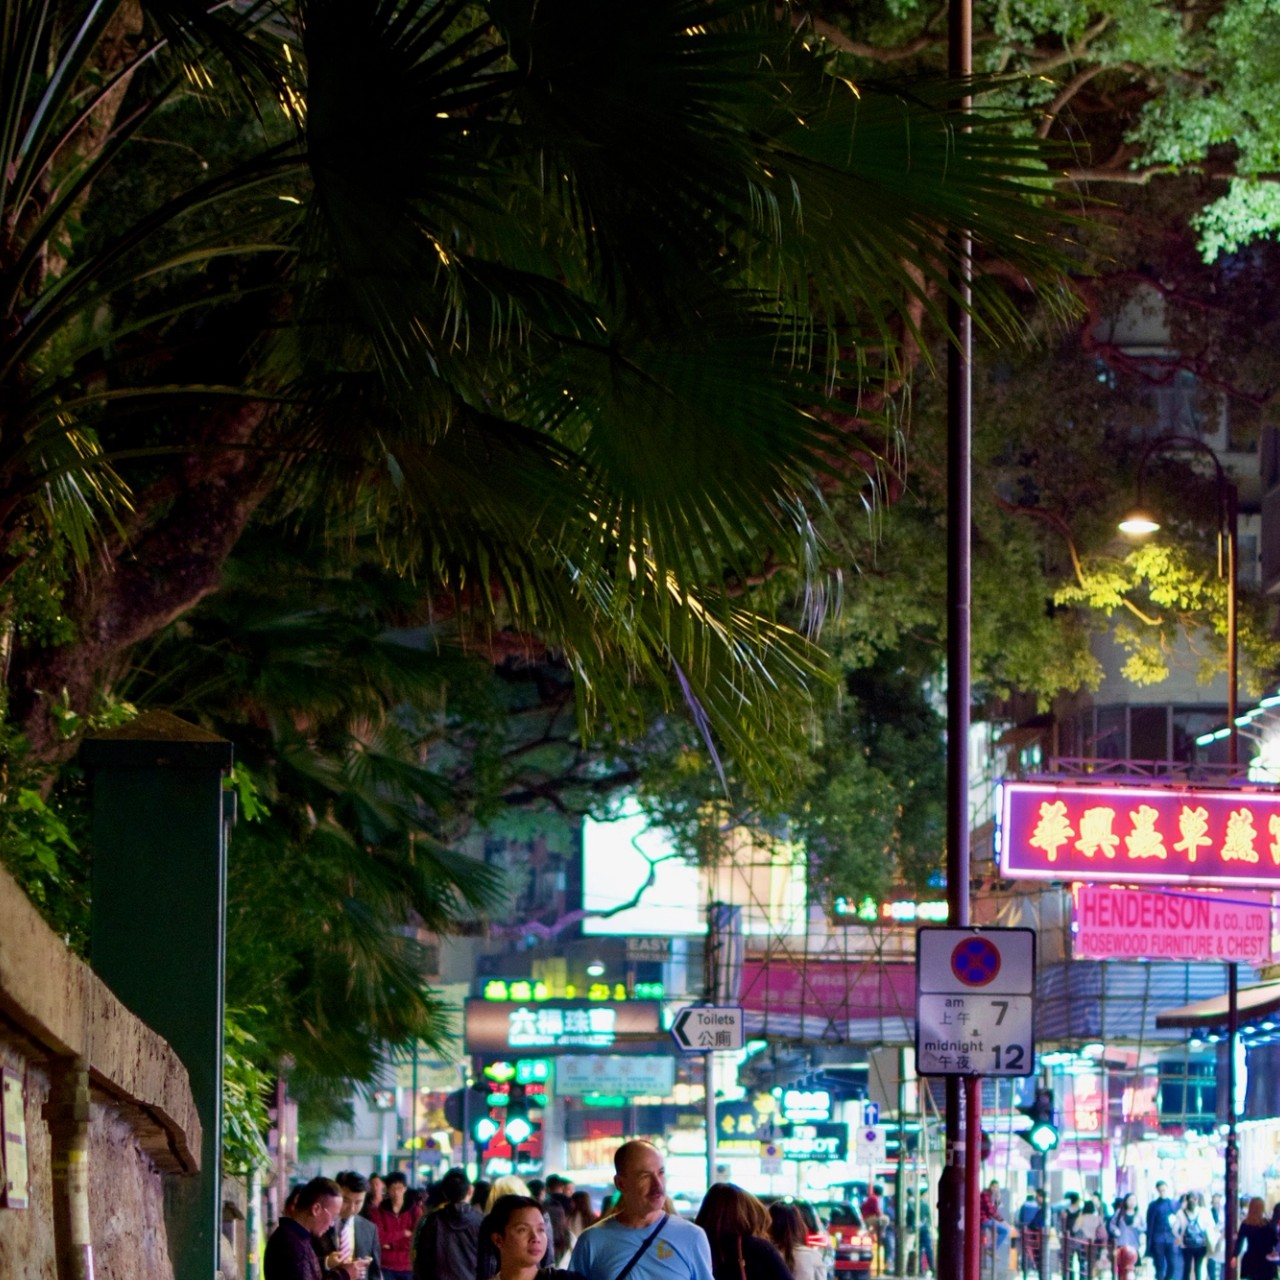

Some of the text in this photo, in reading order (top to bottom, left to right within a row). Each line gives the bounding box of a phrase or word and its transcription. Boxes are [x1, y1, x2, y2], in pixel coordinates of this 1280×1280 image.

[1083, 893, 1210, 930] HENDERSON
[1082, 932, 1264, 957] ROSEWOOD FURNITURE & CHEST
[697, 1013, 735, 1025] Toilets
[939, 1012, 970, 1026] 上午
[945, 999, 1009, 1026] am 7
[925, 1041, 1024, 1070] midnight 12
[938, 1055, 970, 1070] 午夜
